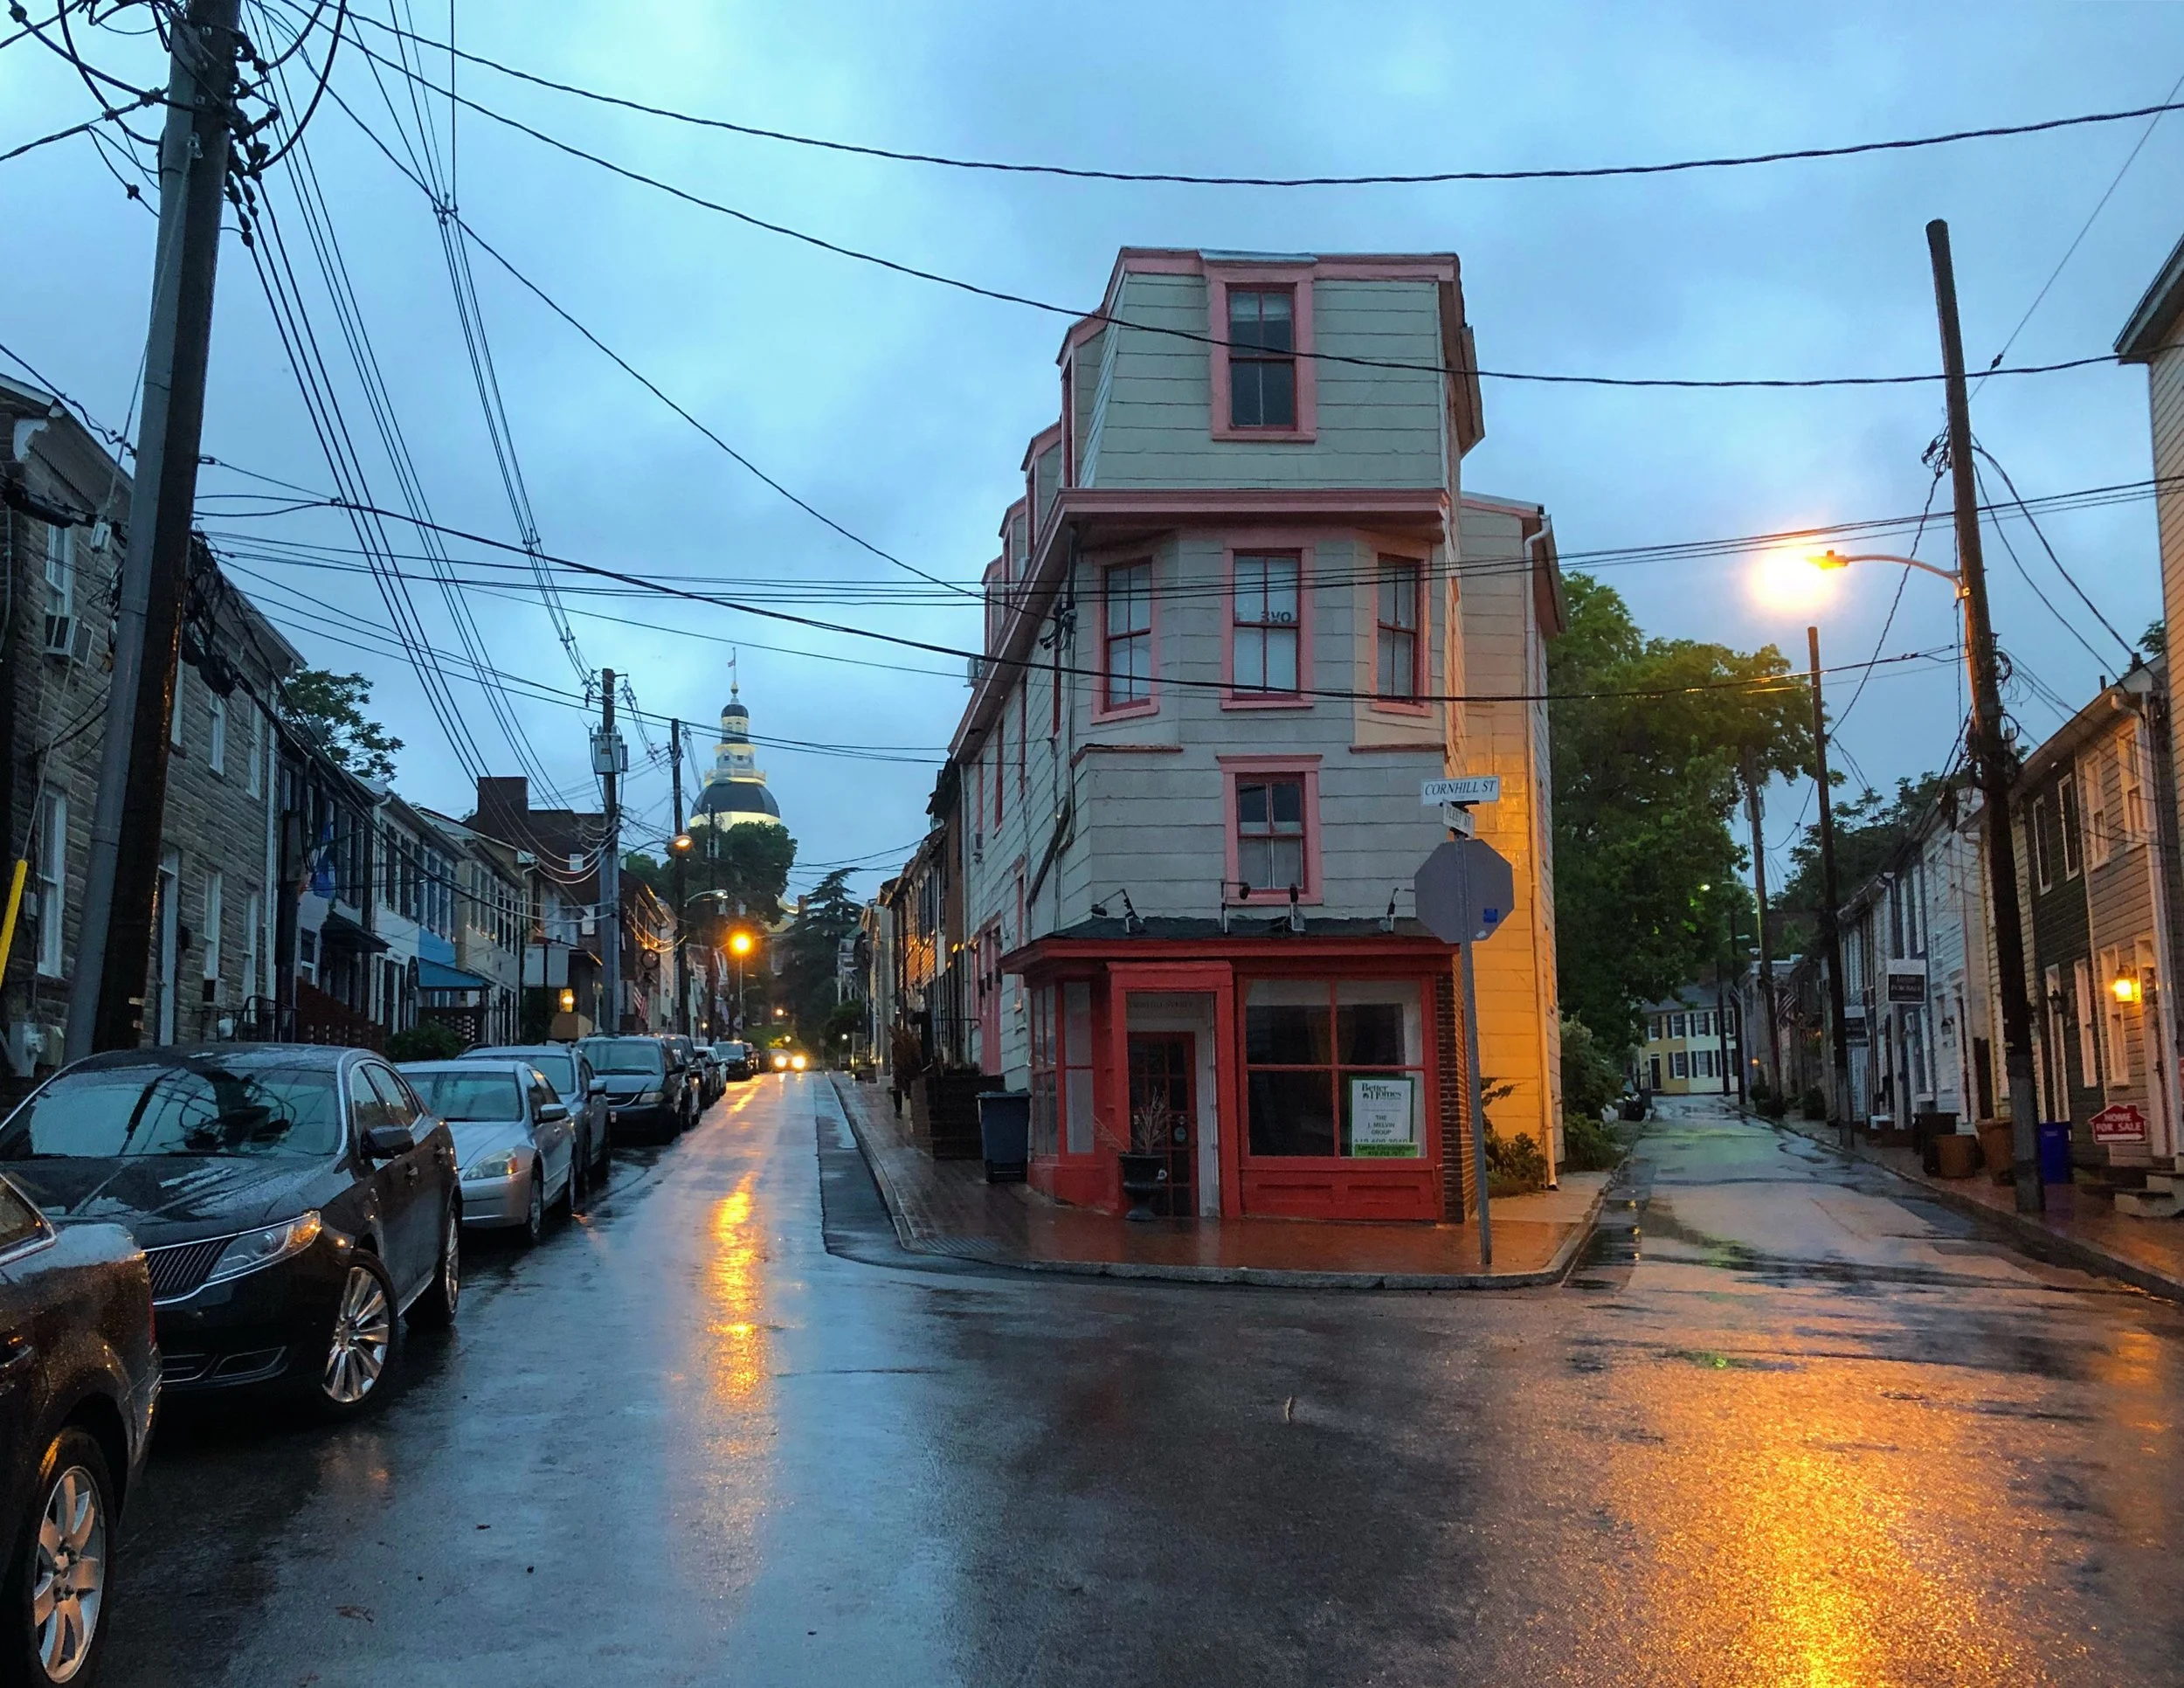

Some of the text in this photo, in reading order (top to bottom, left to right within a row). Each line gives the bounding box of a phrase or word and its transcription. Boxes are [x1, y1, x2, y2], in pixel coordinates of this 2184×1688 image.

[1425, 780, 1496, 796] CORNHILL ST
[1446, 806, 1463, 823] FLEET
[1361, 1083, 1389, 1092] Better
[1370, 1090, 1402, 1100] Homes
[2104, 1113, 2132, 1122] HOME
[2096, 1122, 2141, 1132] FOR SALE
